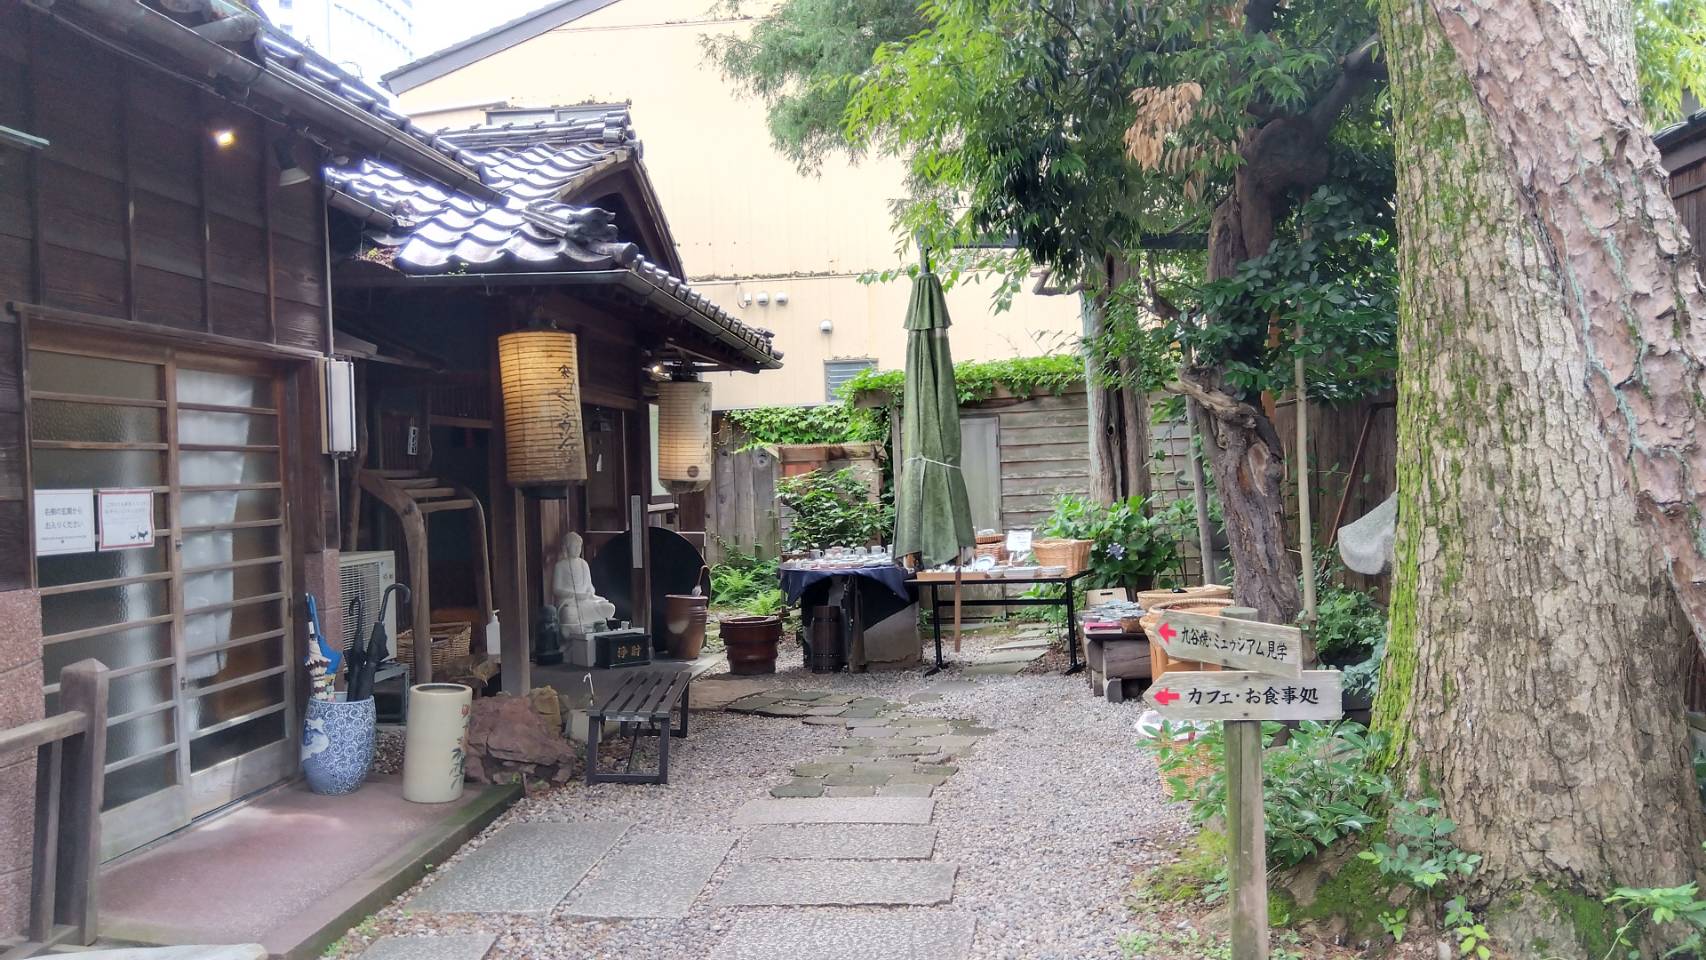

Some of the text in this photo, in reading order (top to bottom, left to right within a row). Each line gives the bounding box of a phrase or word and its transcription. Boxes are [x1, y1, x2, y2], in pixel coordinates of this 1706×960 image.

[1188, 685, 1319, 705] カフェ・お食事処
